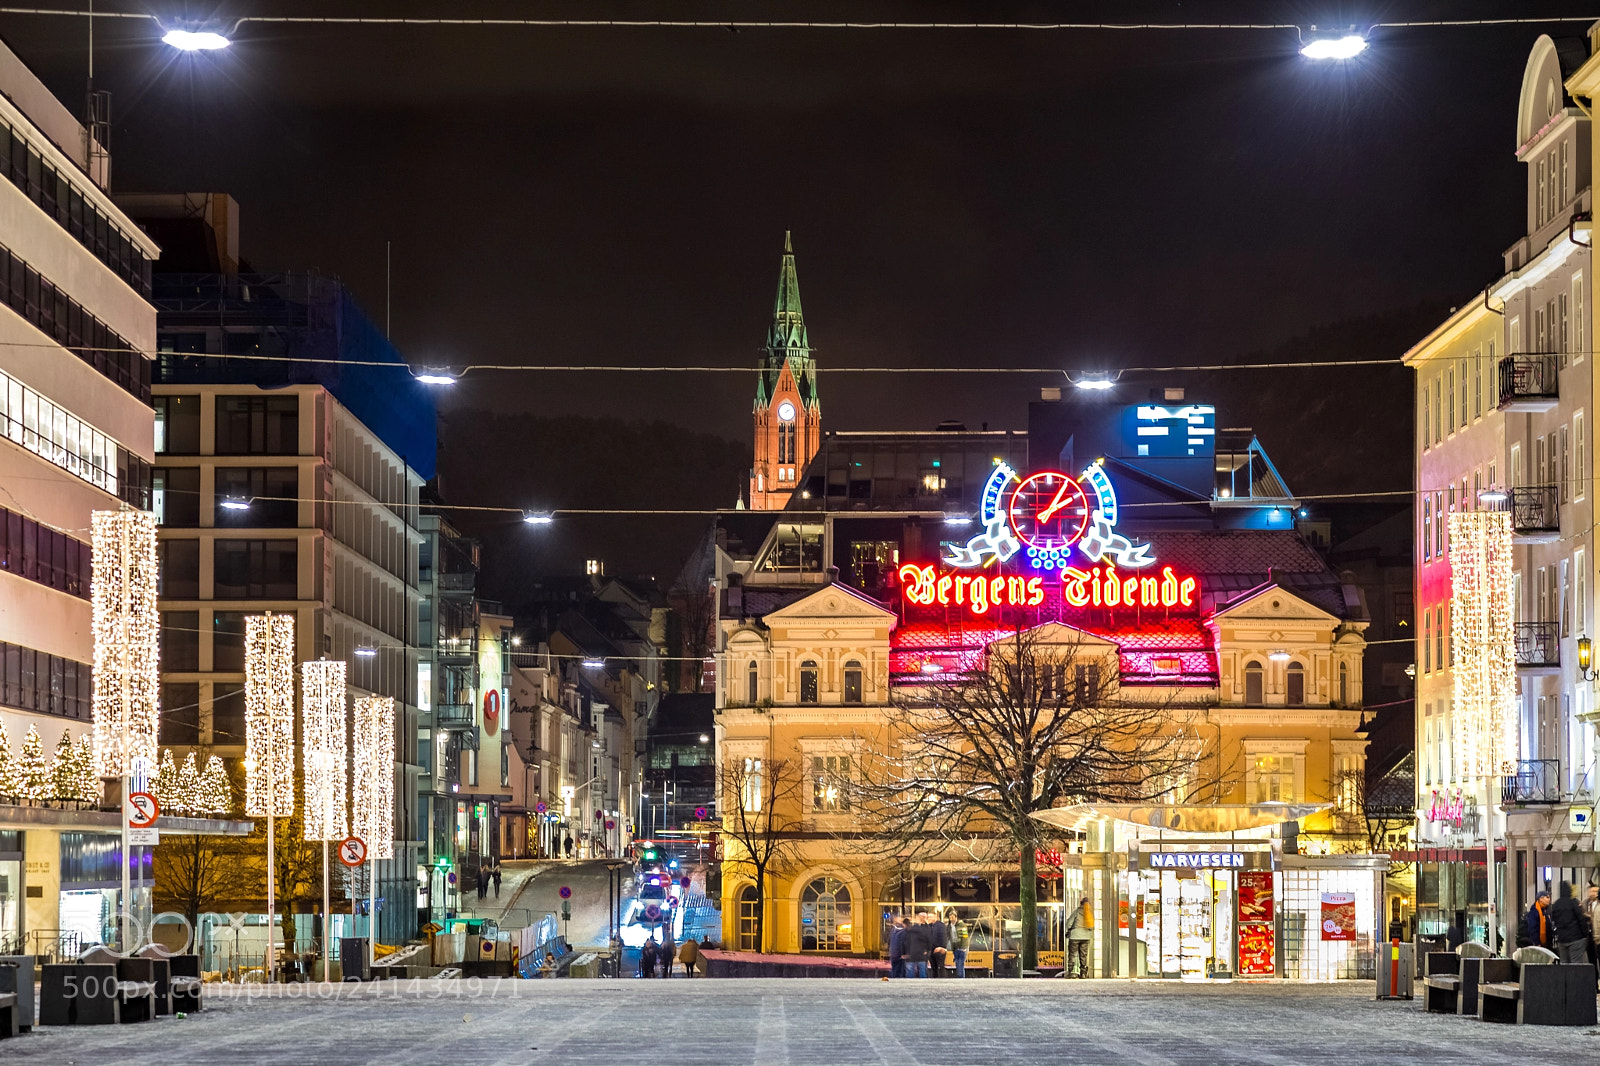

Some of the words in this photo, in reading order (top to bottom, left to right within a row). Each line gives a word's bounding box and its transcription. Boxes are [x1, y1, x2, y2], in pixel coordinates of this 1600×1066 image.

[985, 475, 1005, 514] ANNO
[898, 563, 1046, 614] Bergens
[1060, 566, 1197, 607] Tidende
[1150, 853, 1245, 868] NARVESEN
